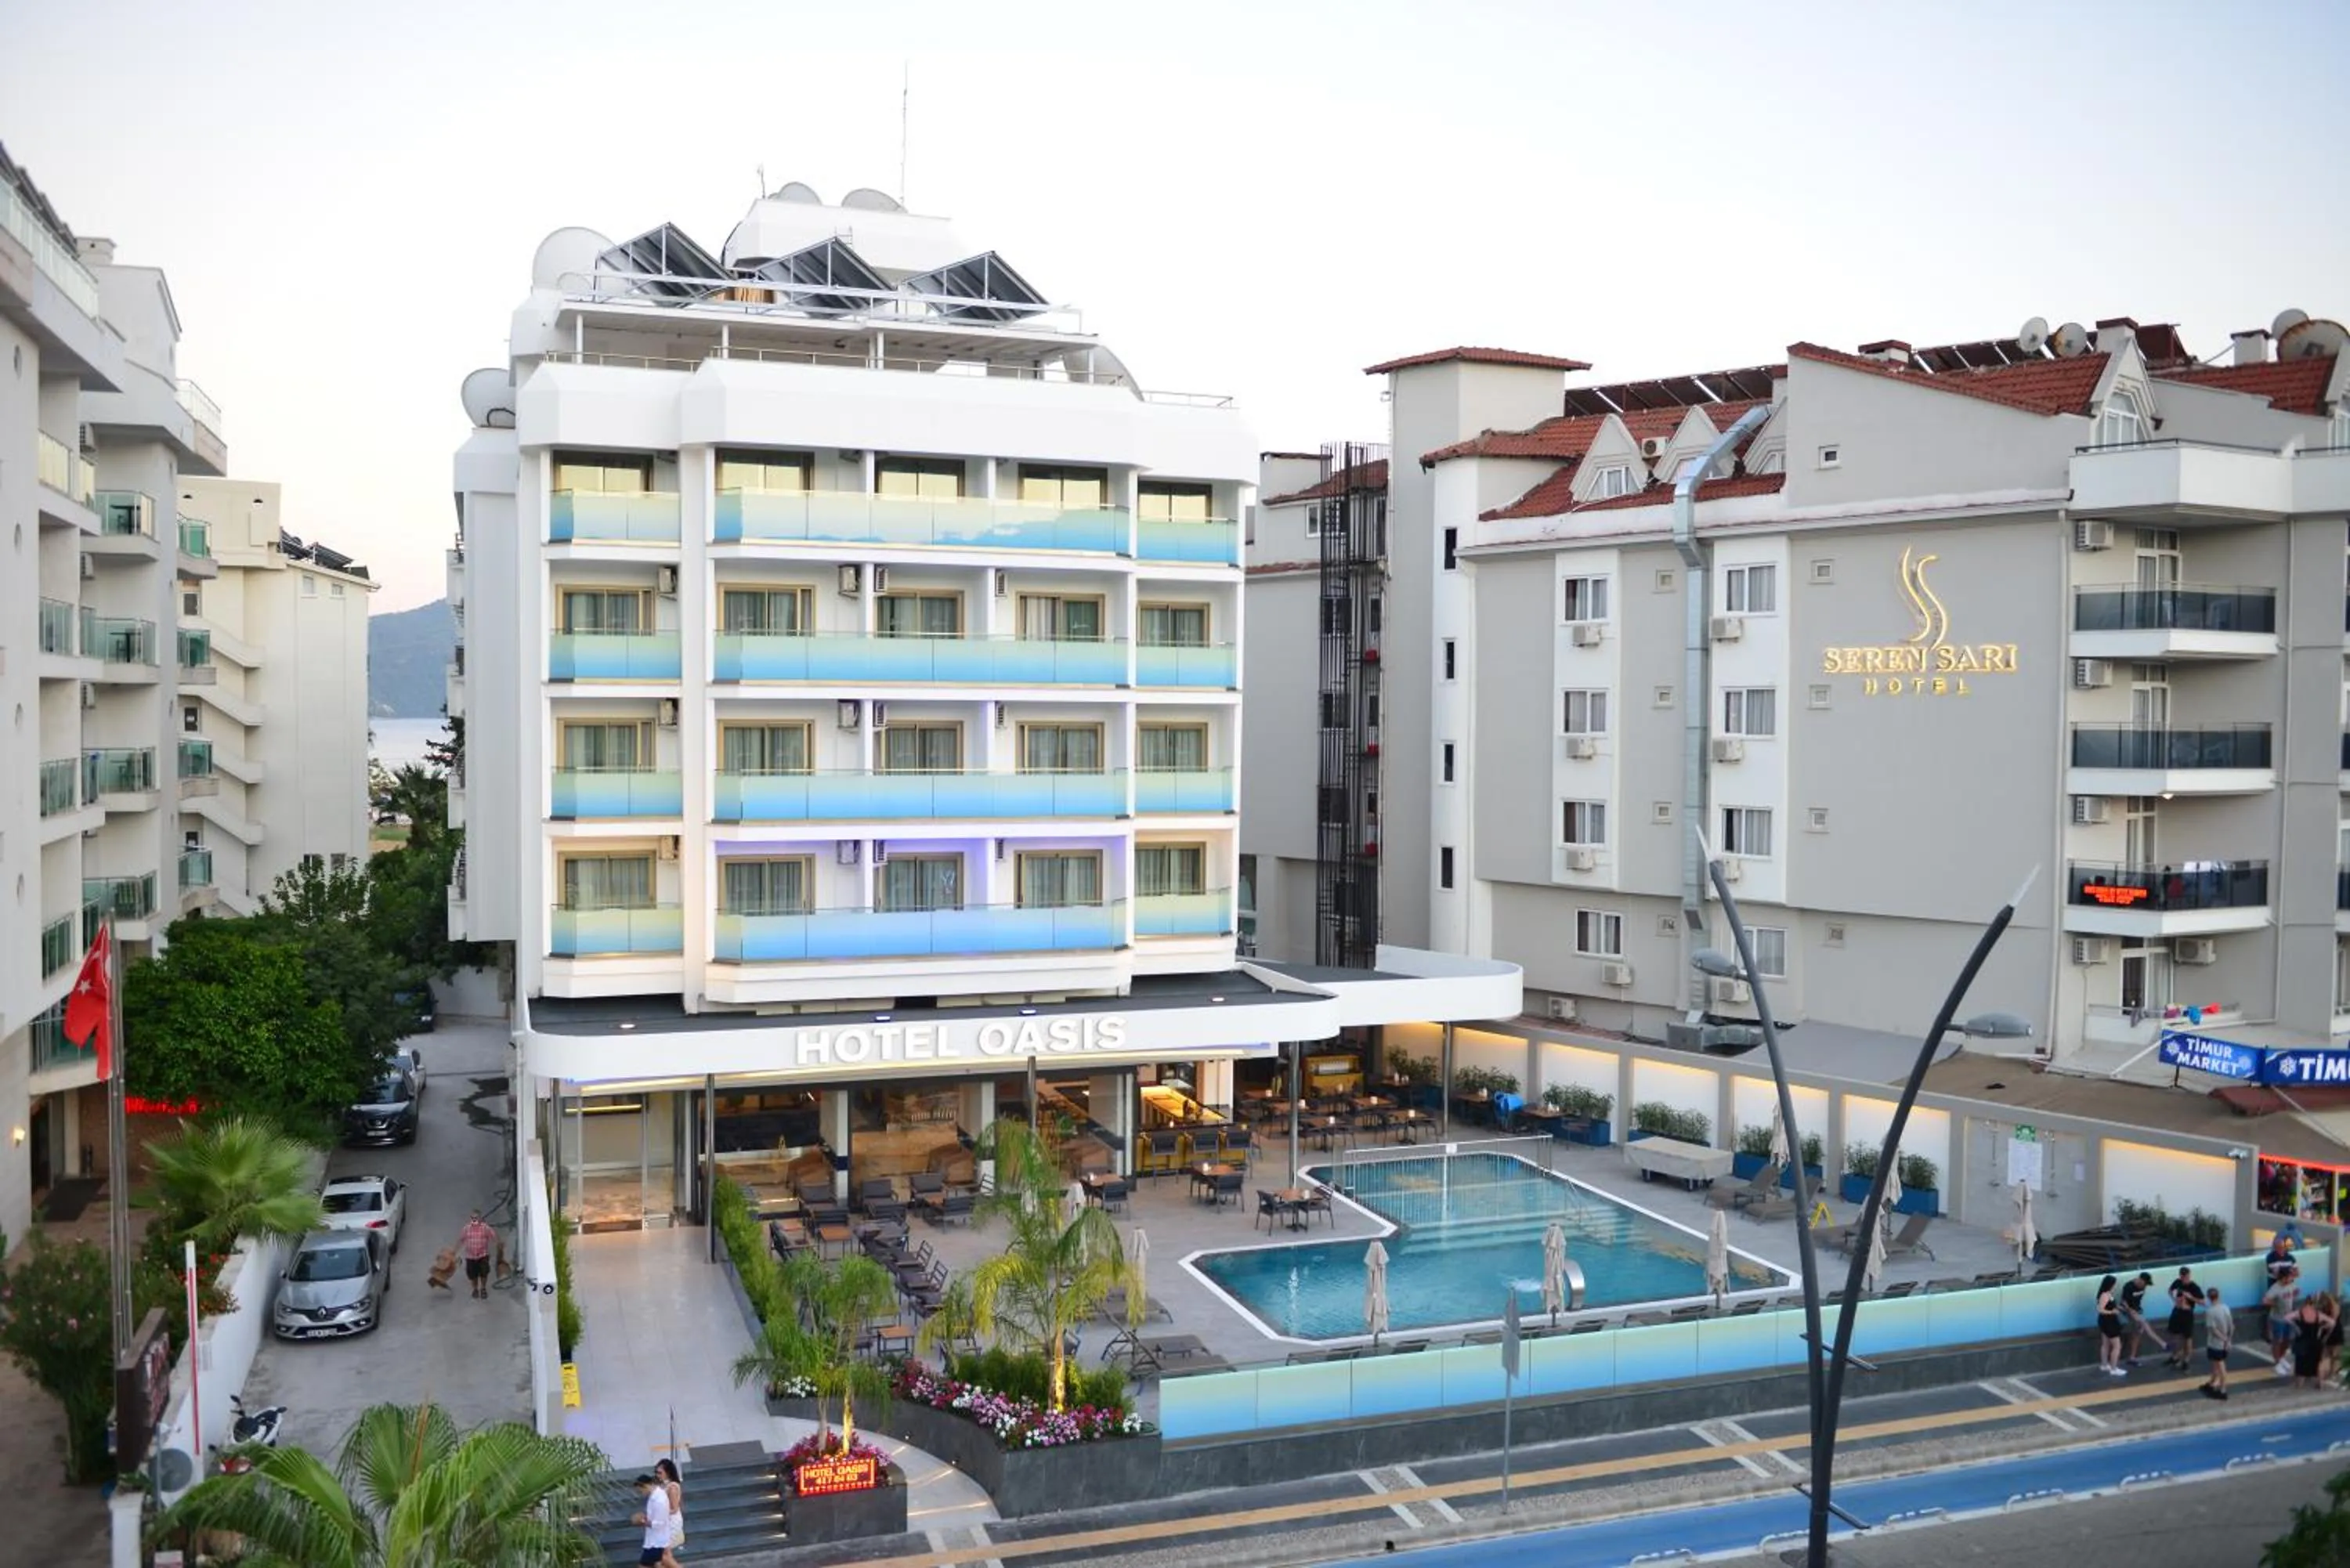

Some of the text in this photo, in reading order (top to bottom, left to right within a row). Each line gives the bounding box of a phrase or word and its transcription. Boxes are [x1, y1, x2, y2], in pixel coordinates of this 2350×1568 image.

[1824, 645, 2019, 673] SEREN SARI
[1864, 677, 1970, 695] HOTEL
[795, 1018, 1126, 1064] HOTEL OASIS
[2177, 1052, 2239, 1075] MARKET
[2299, 1053, 2350, 1081] TİM
[804, 1467, 834, 1479] HOTEL
